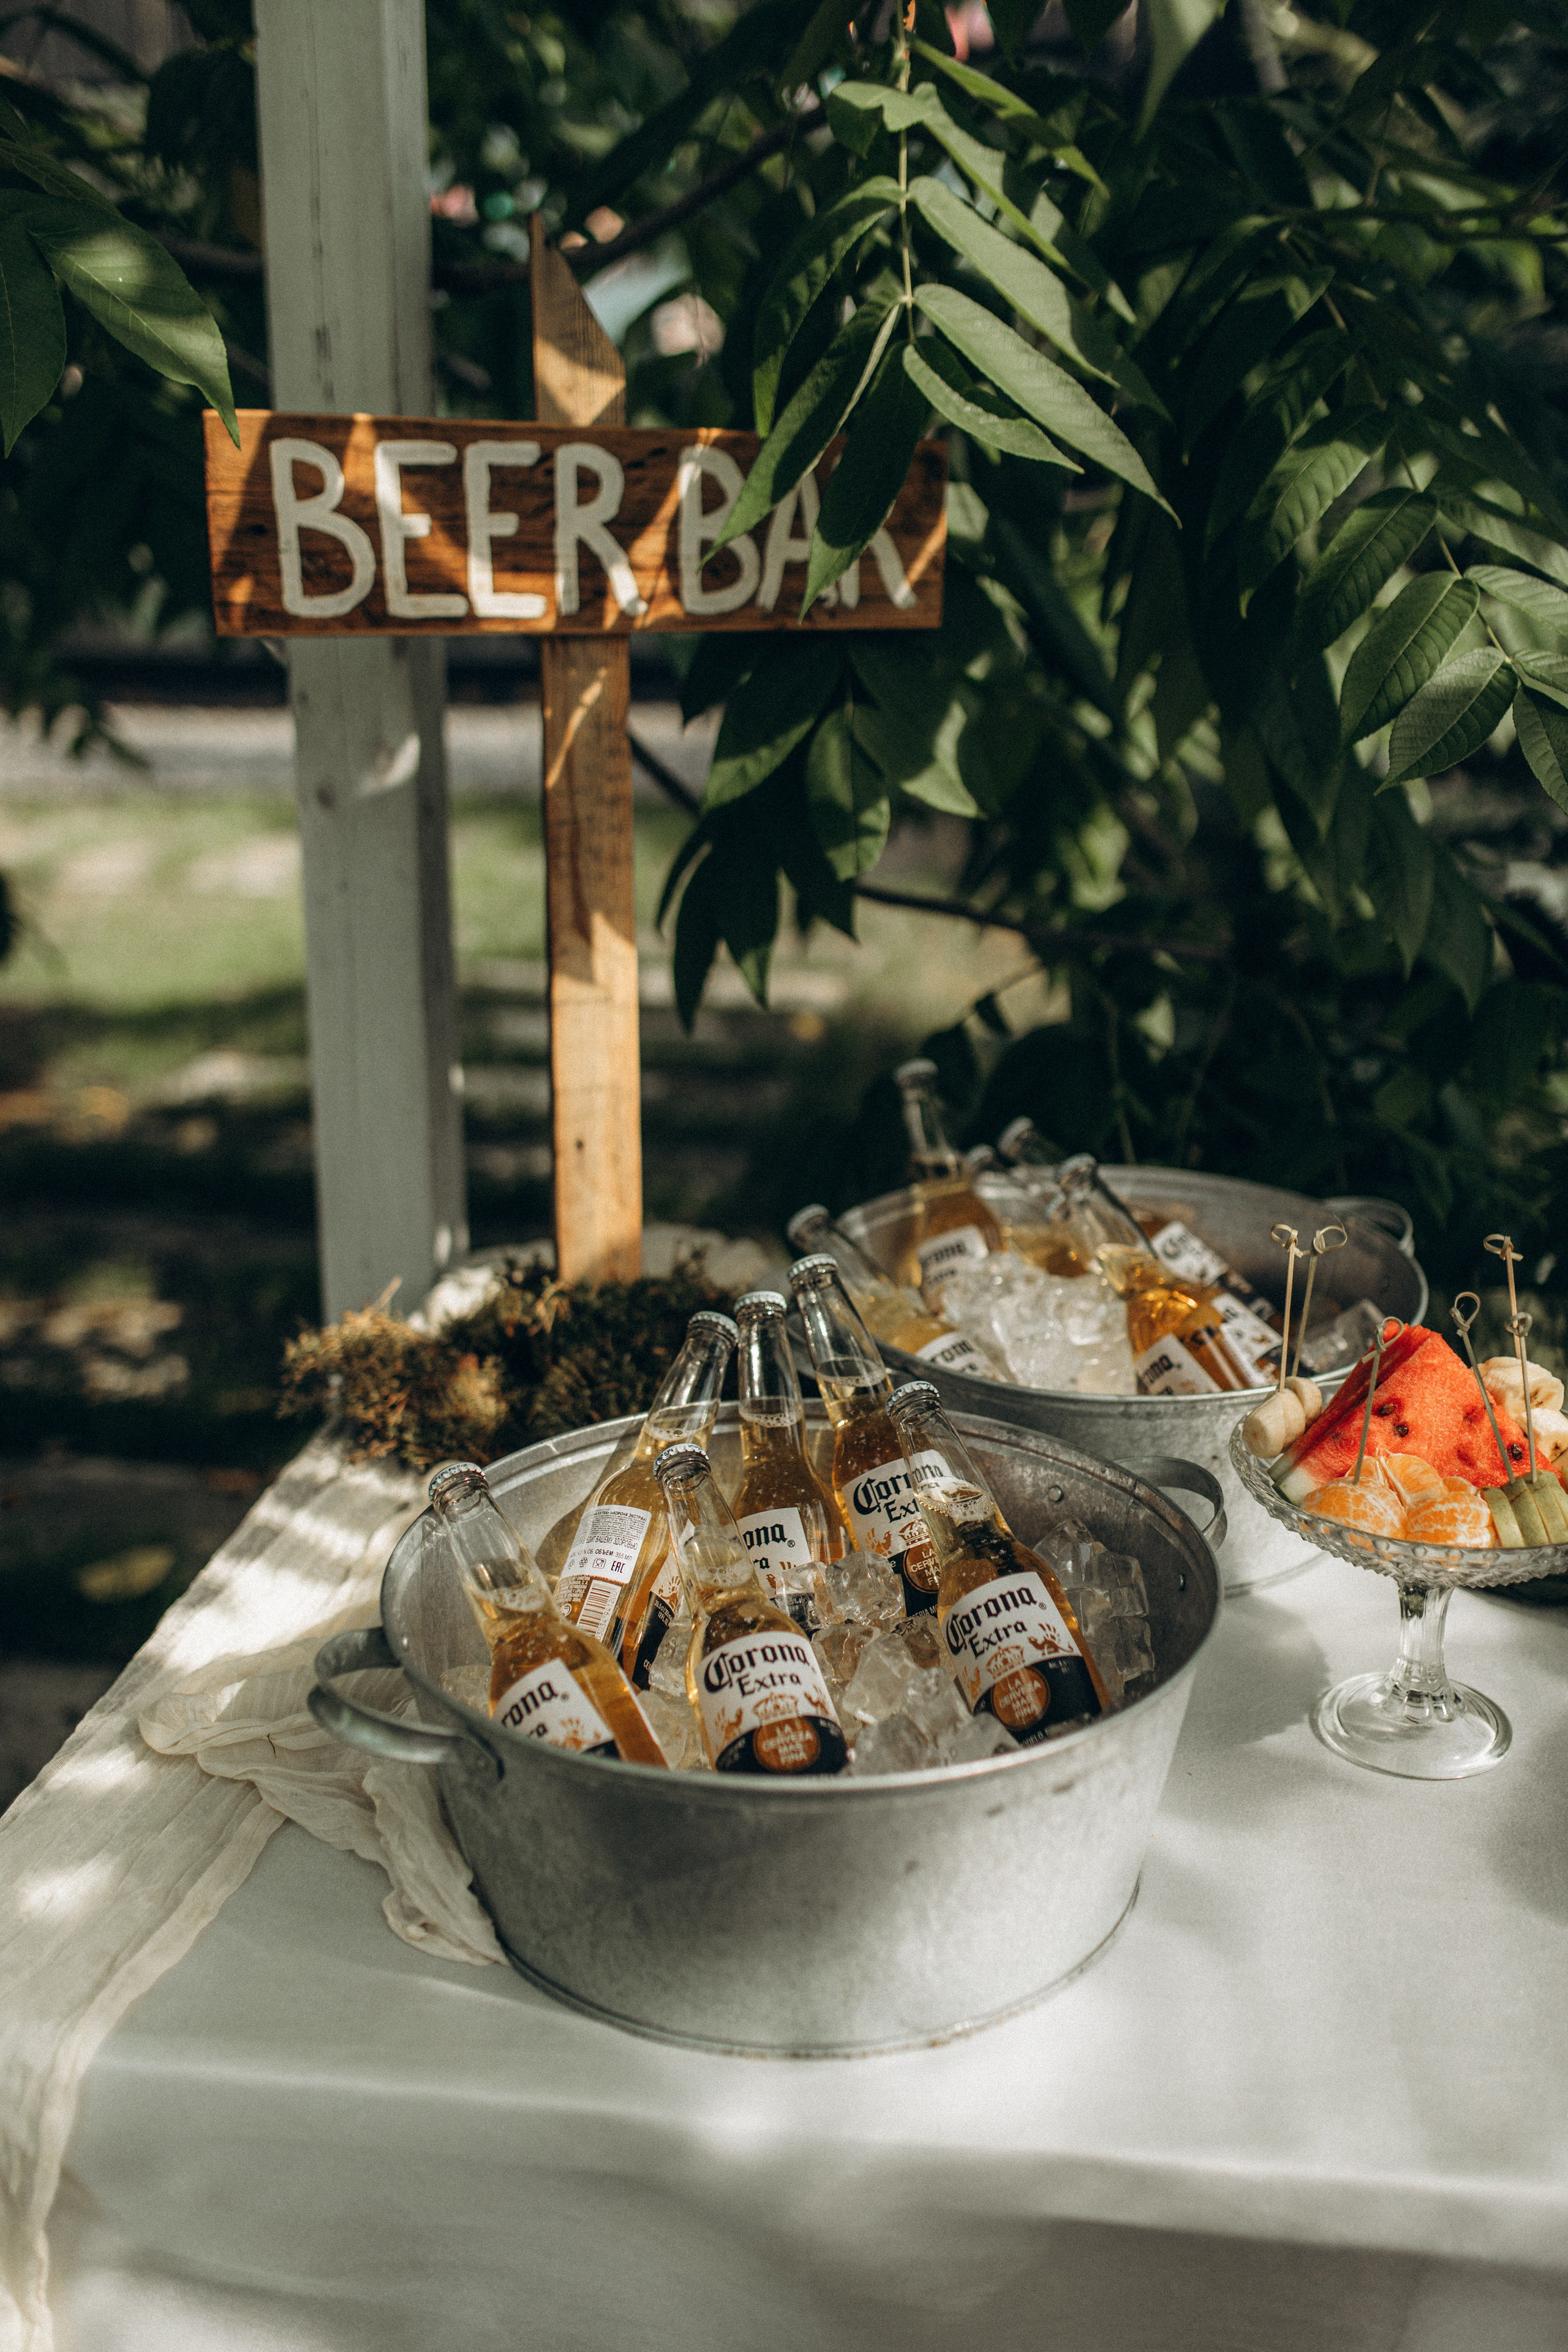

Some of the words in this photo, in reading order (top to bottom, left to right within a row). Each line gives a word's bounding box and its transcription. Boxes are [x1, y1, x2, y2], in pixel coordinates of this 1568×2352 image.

[270, 437, 648, 619] BEER
[595, 1536, 612, 1544] ВАШЕМУ
[613, 1537, 638, 1550] ЗДОРОВЬЮ
[742, 1523, 788, 1550] ona
[922, 1548, 936, 1558] LA
[924, 1566, 940, 1577] MA
[946, 1586, 1037, 1656] Corona
[968, 1620, 1028, 1660] Extra
[704, 1644, 810, 1695] Corona
[736, 1672, 802, 1698] Extra
